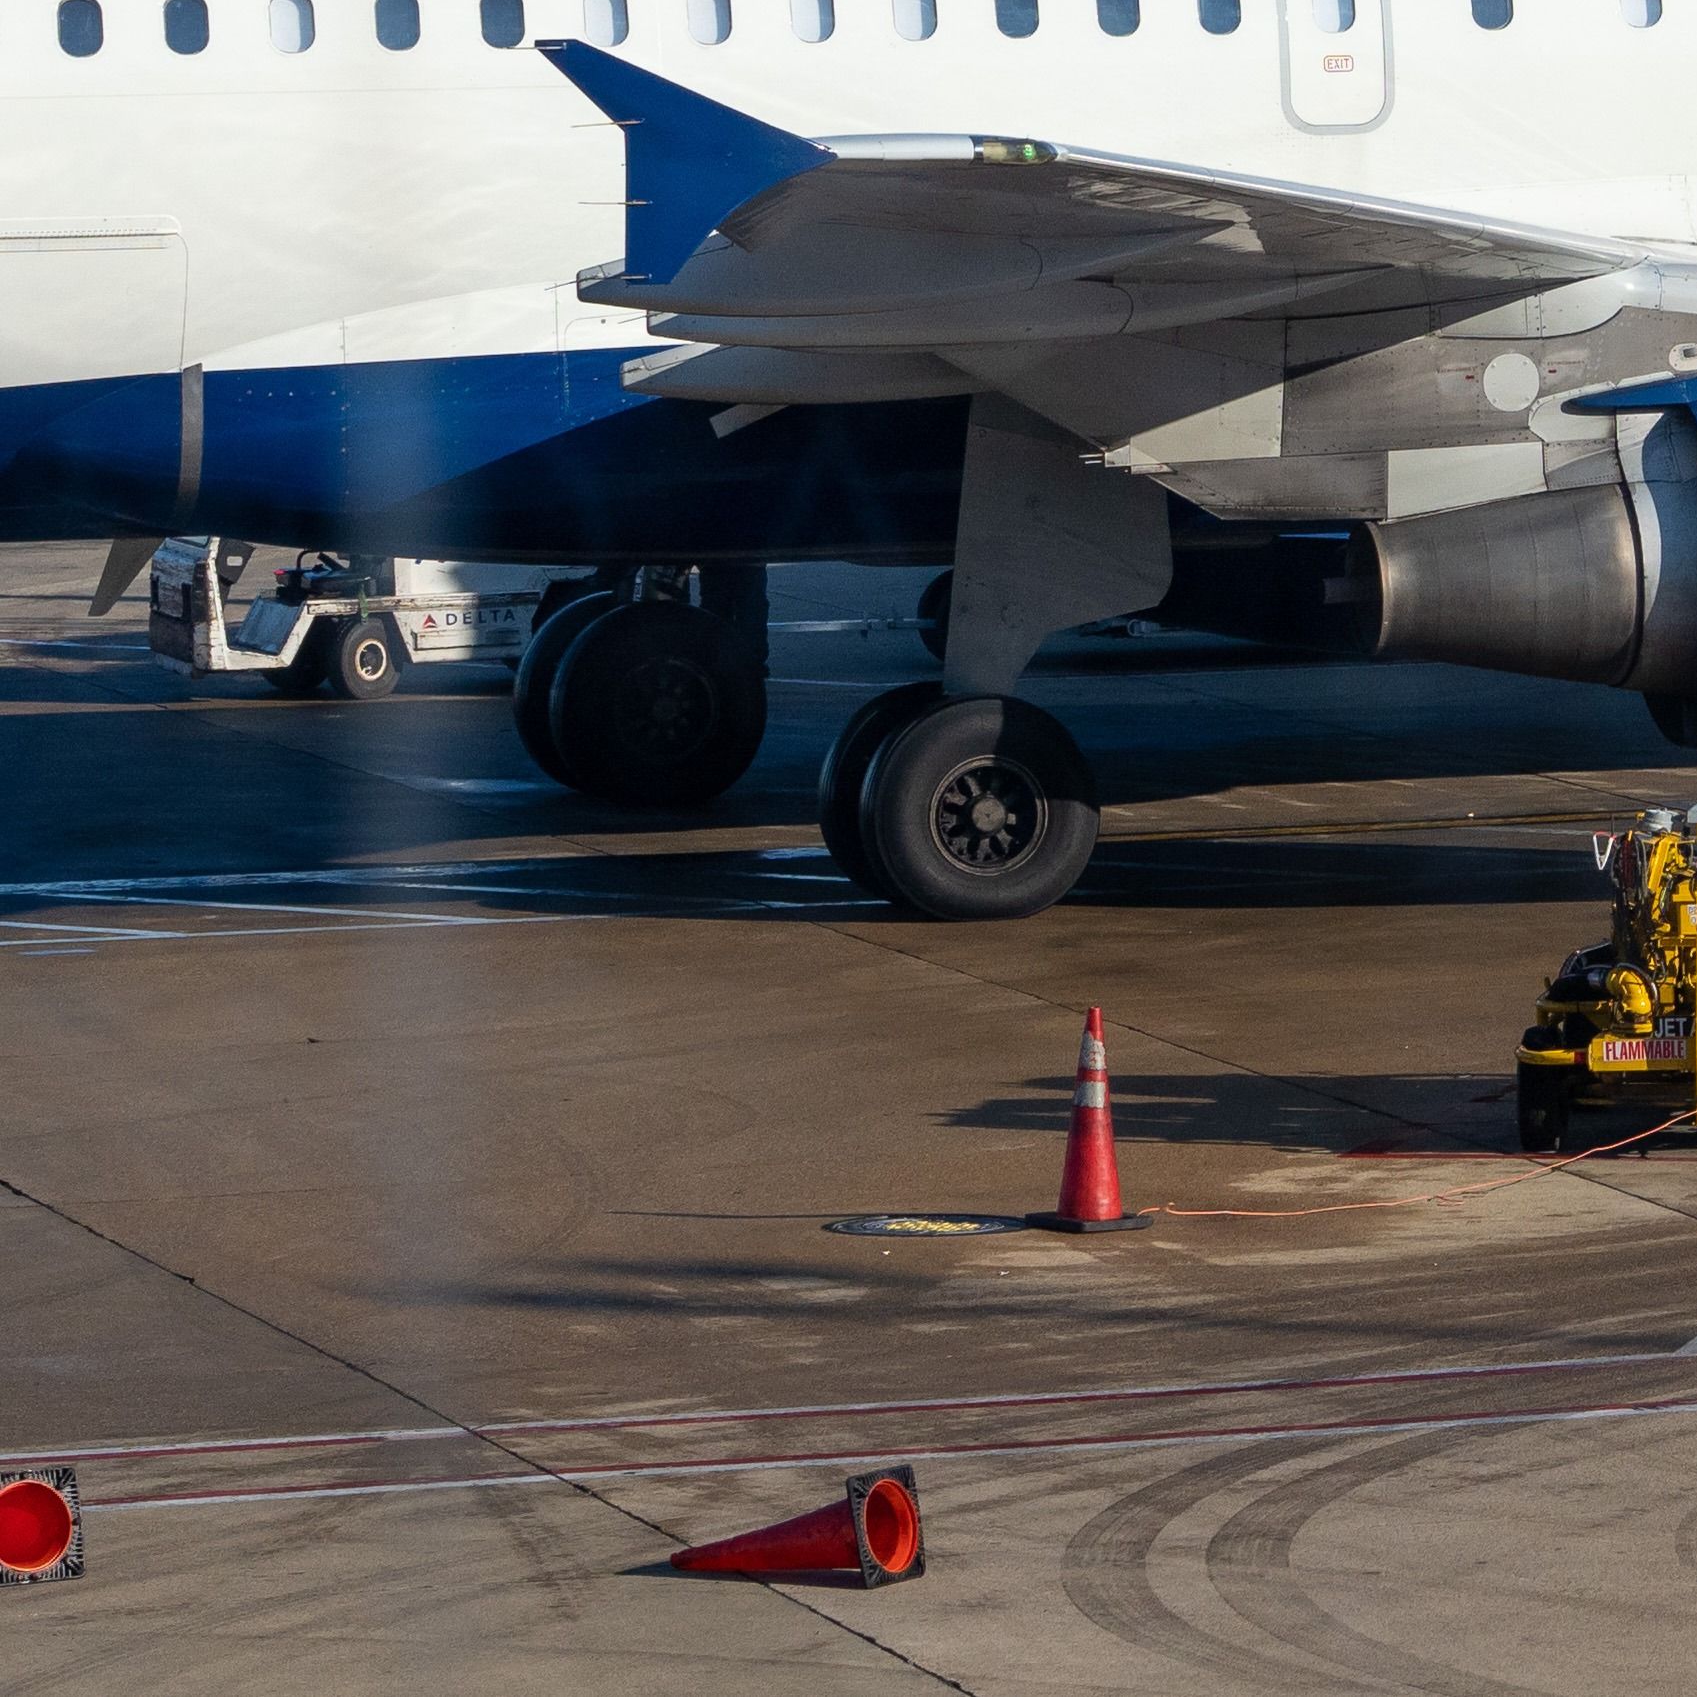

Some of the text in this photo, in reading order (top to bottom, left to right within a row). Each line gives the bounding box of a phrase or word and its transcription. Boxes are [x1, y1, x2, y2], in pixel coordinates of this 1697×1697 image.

[1326, 57, 1350, 70] EXIT
[445, 608, 516, 626] DELTA
[1654, 1017, 1687, 1038] JET
[1604, 1039, 1685, 1061] FLAMMABLE
